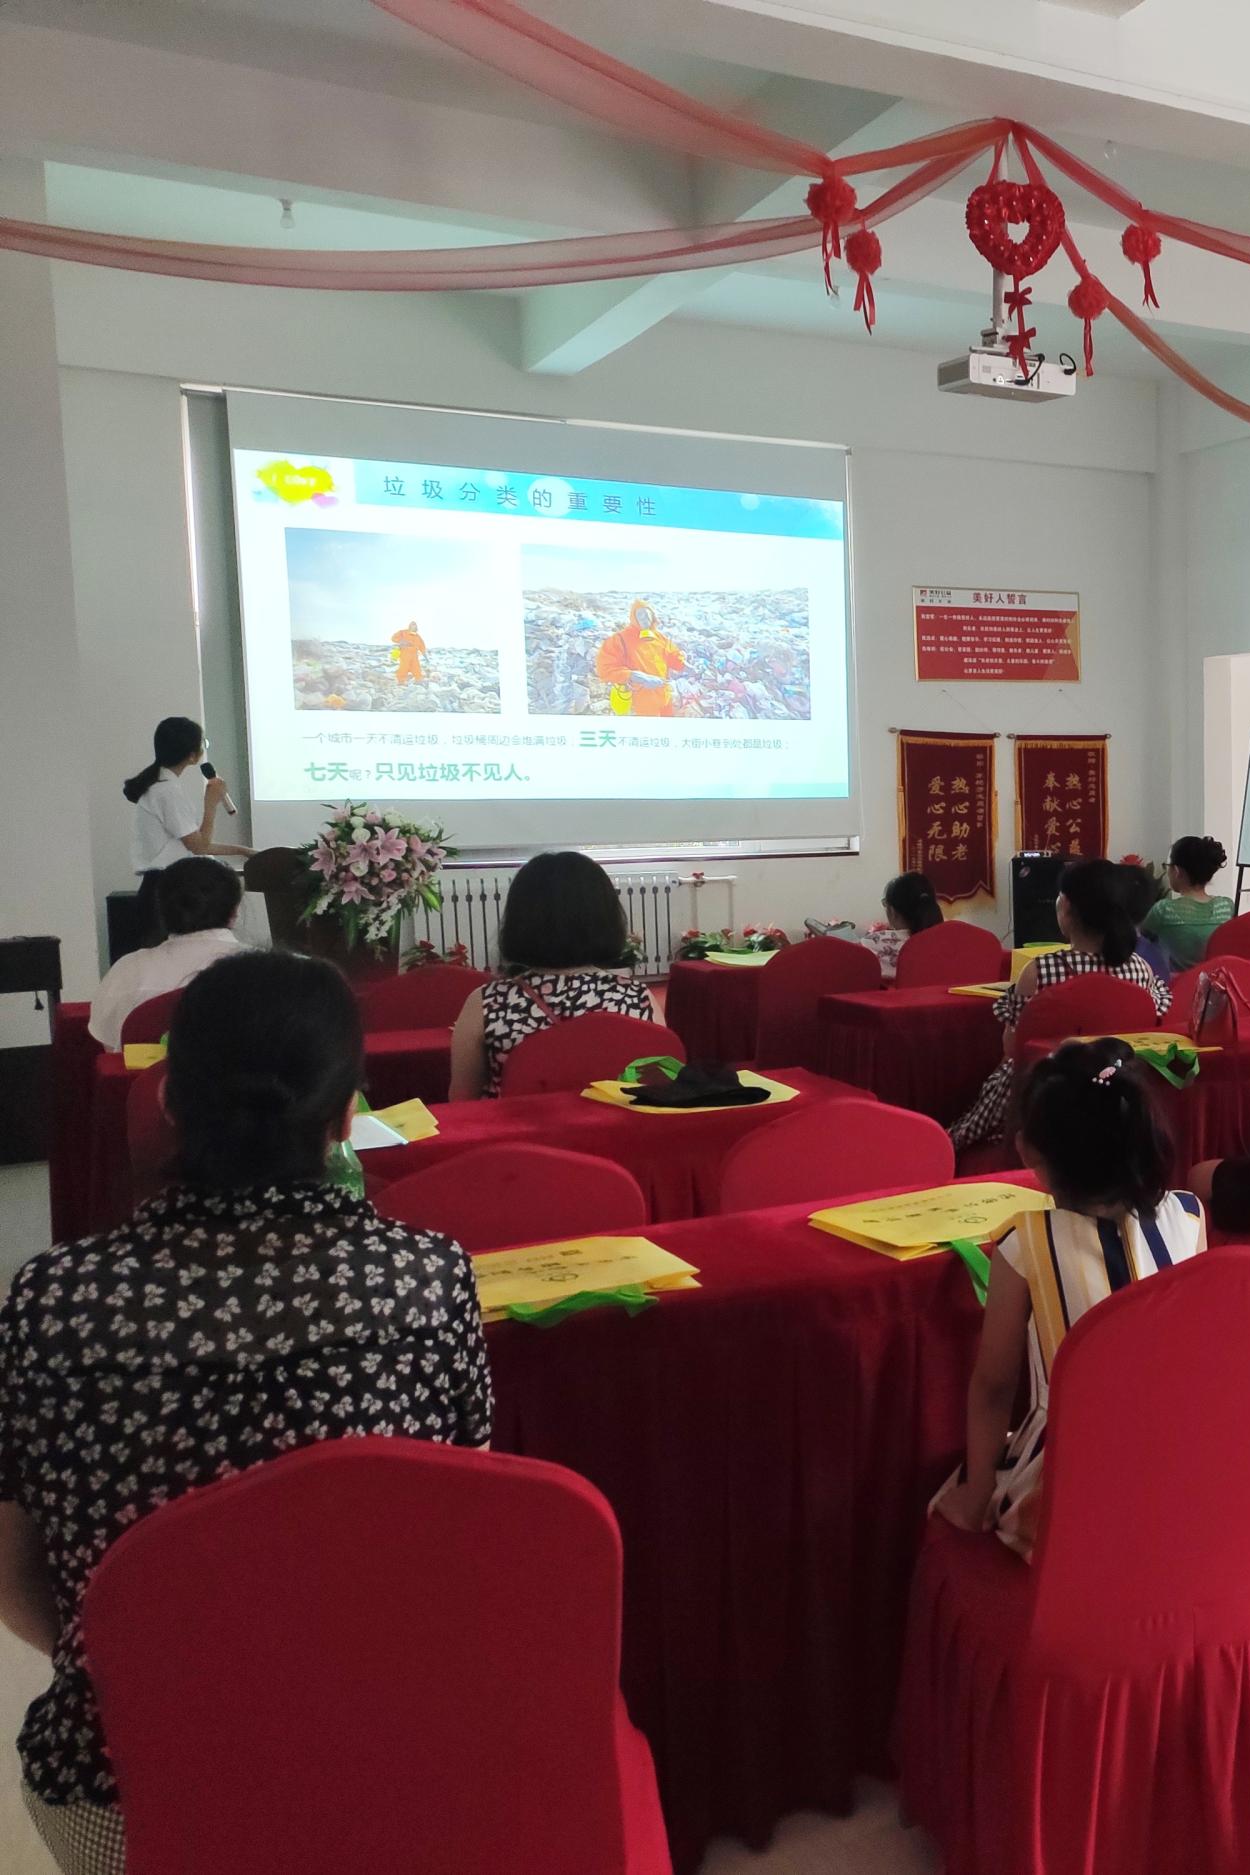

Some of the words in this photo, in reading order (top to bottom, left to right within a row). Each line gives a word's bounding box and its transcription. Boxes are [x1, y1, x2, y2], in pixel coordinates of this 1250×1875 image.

[383, 474, 657, 517] 垃圾分类的重要性
[972, 592, 1028, 606] 美好人誓言
[926, 775, 949, 862] 爱心无限
[950, 775, 971, 861] 热心助老
